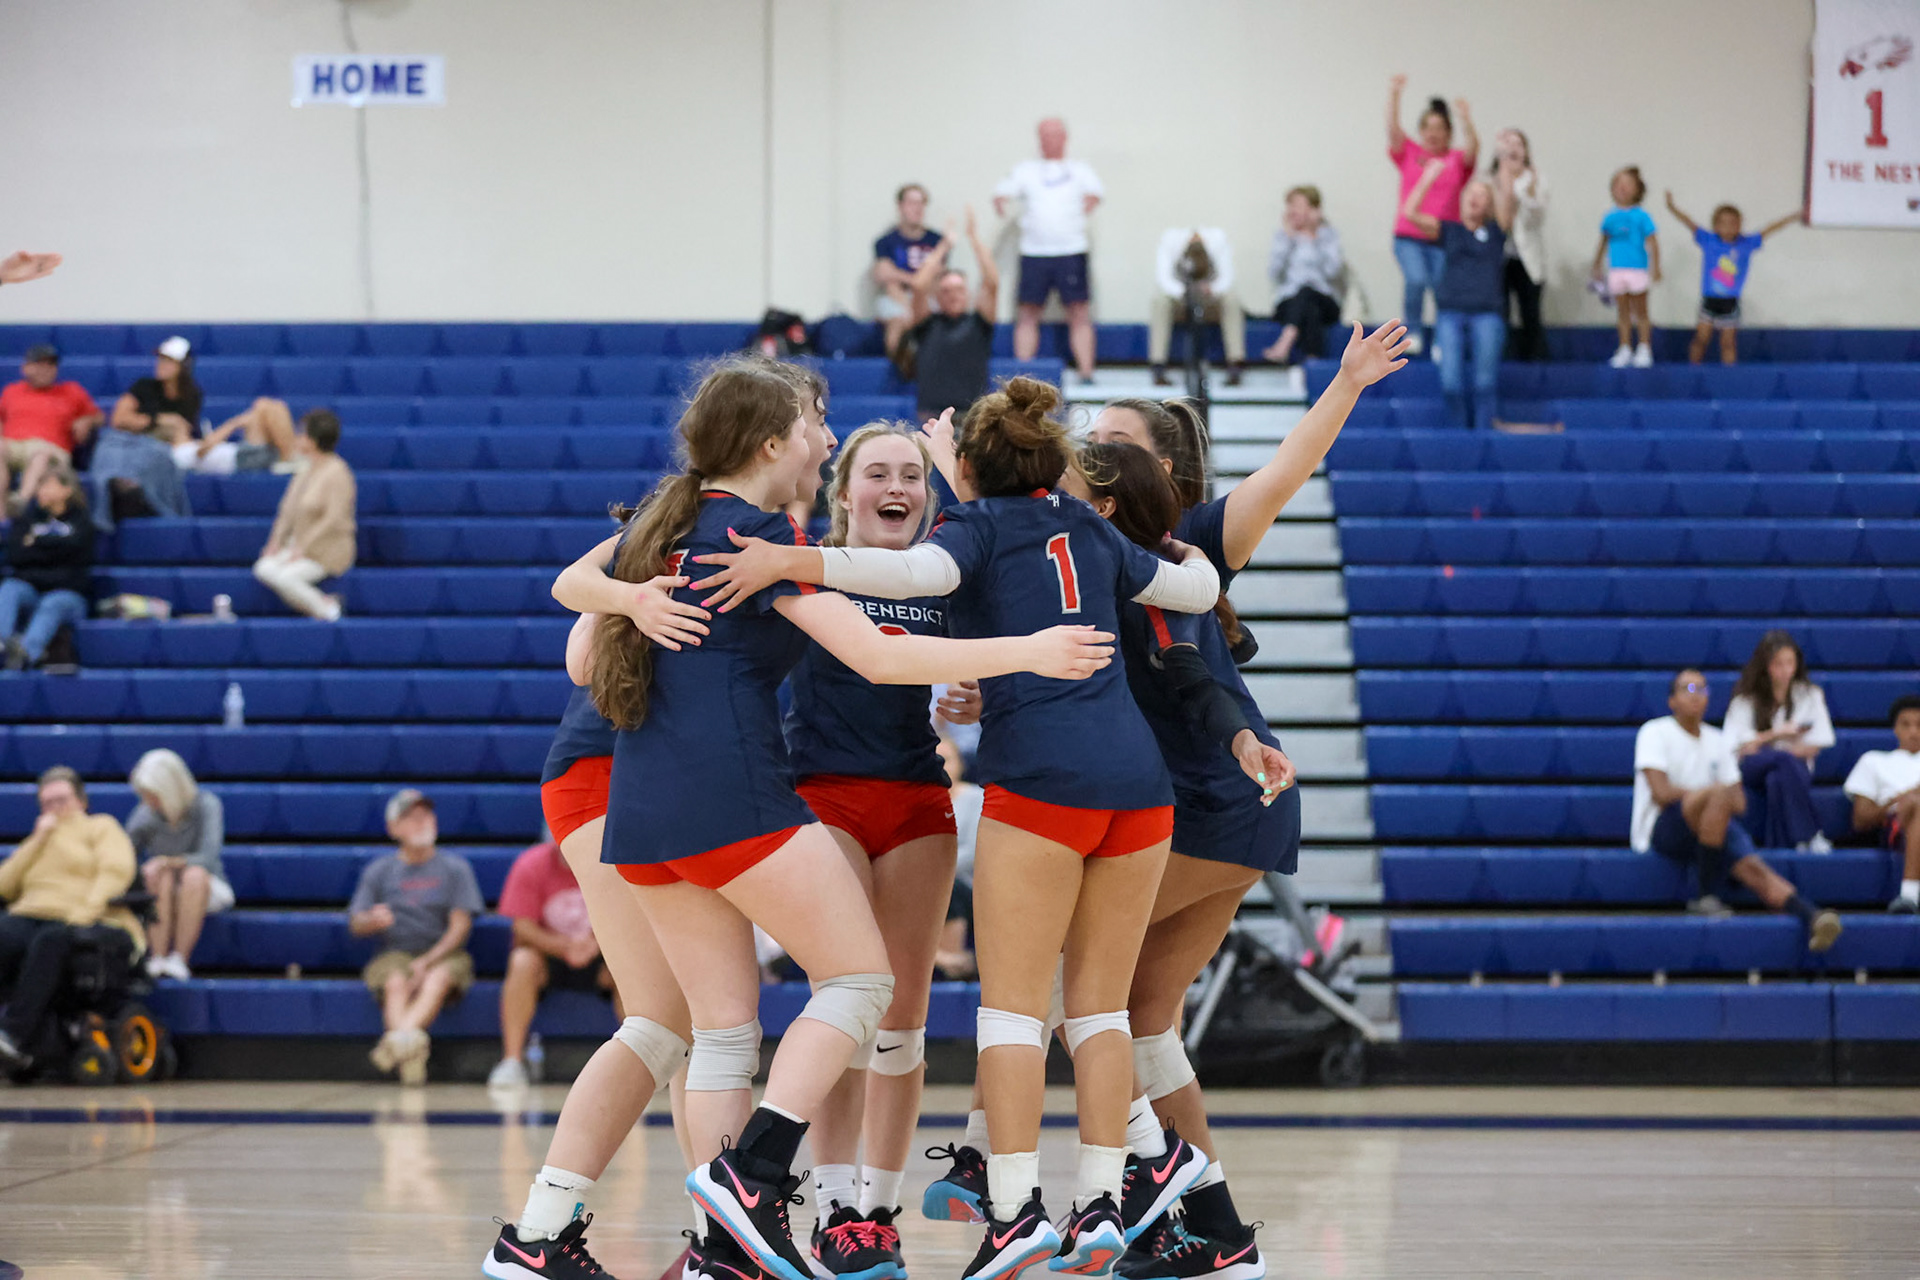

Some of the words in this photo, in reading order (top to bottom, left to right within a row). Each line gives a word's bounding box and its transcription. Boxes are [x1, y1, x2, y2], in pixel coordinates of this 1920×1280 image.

[313, 64, 426, 94] HOME
[1865, 88, 1888, 147] 1
[1827, 161, 1864, 182] THE
[1045, 532, 1081, 614] 1
